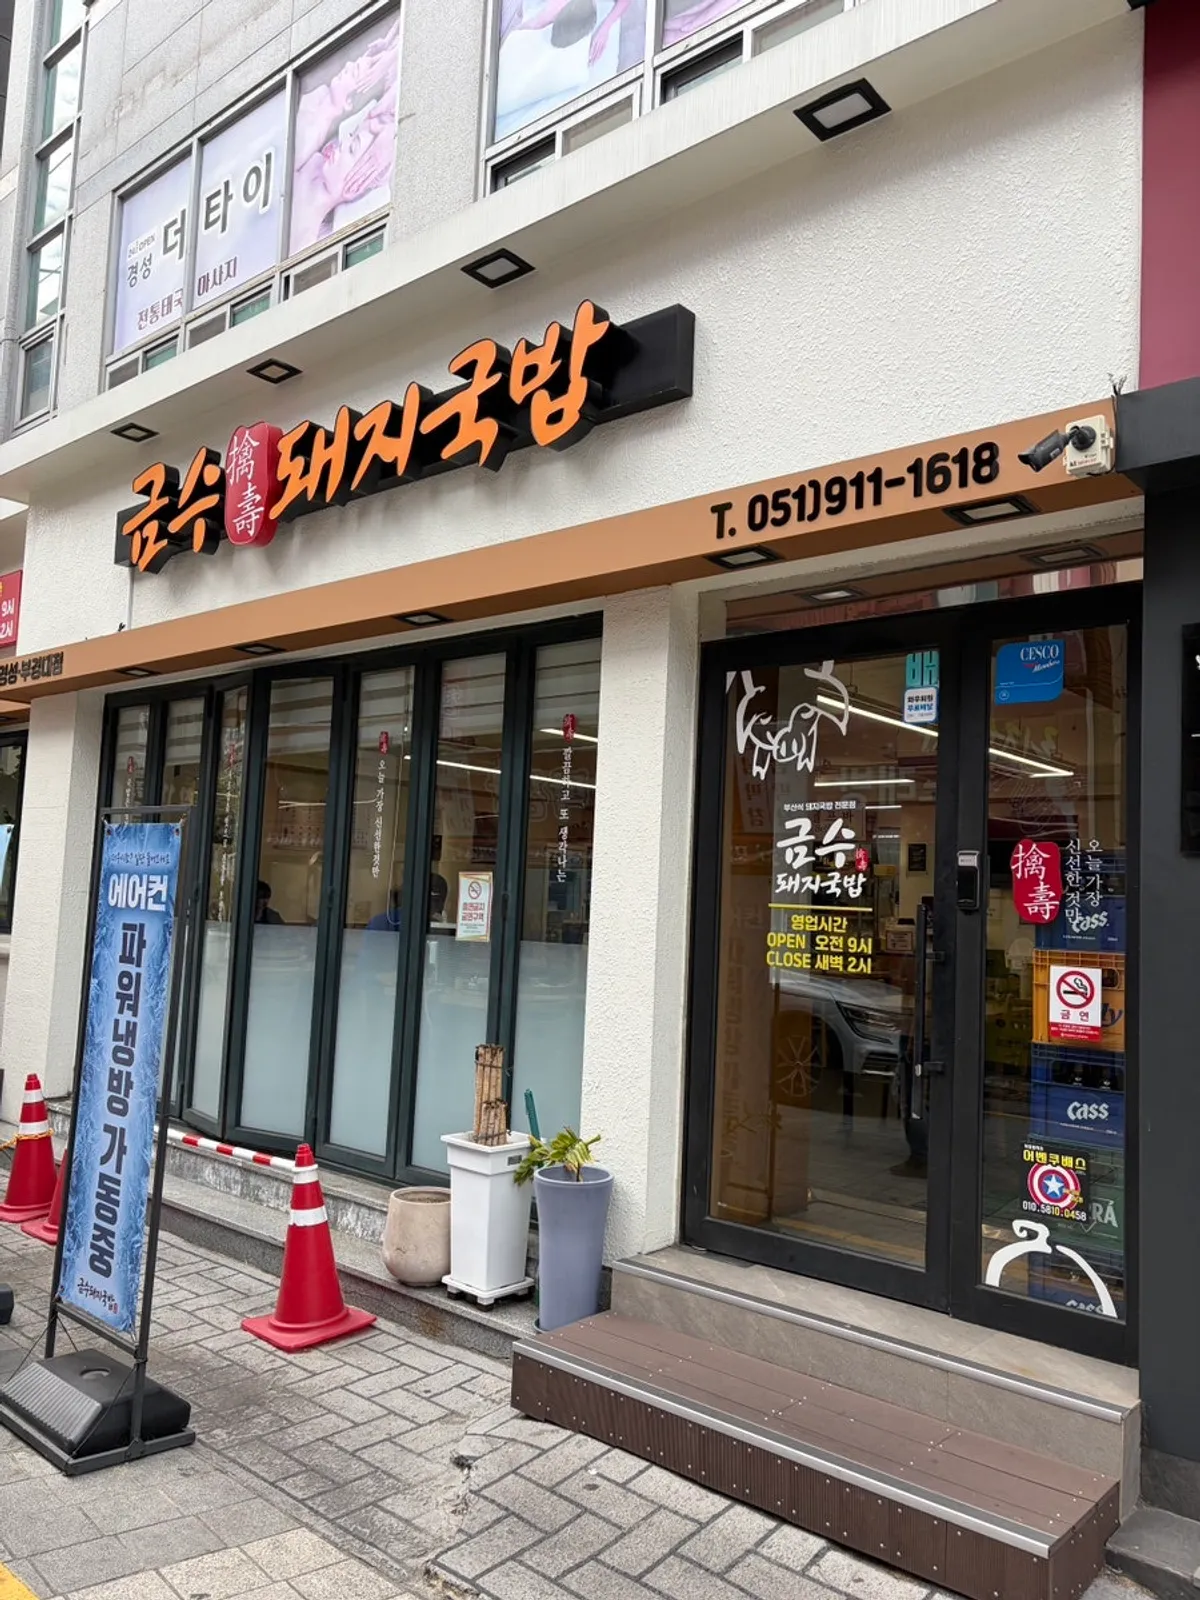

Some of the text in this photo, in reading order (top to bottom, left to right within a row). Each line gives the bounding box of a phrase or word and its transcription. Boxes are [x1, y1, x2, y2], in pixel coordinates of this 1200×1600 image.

[127, 253, 152, 288] 경성
[197, 256, 238, 297] 마사지
[267, 299, 610, 522] 돼지국밥
[121, 446, 220, 573] 금수
[710, 441, 1000, 539] T. 051)911-1618
[1020, 644, 1060, 661] CESCO
[776, 817, 857, 870] 금수
[108, 872, 169, 912] 에어컨
[775, 872, 867, 899] 돼지국밥
[1085, 838, 1103, 907] 오늘 가장
[766, 931, 806, 949] OPEN
[815, 935, 844, 953] 오전
[847, 936, 873, 955] 9시
[791, 914, 848, 934] 영업시간
[766, 951, 872, 974] CLOSE 새벽 2시
[89, 922, 147, 1279] 파워냉방 가동중
[1066, 1100, 1110, 1121] Cass
